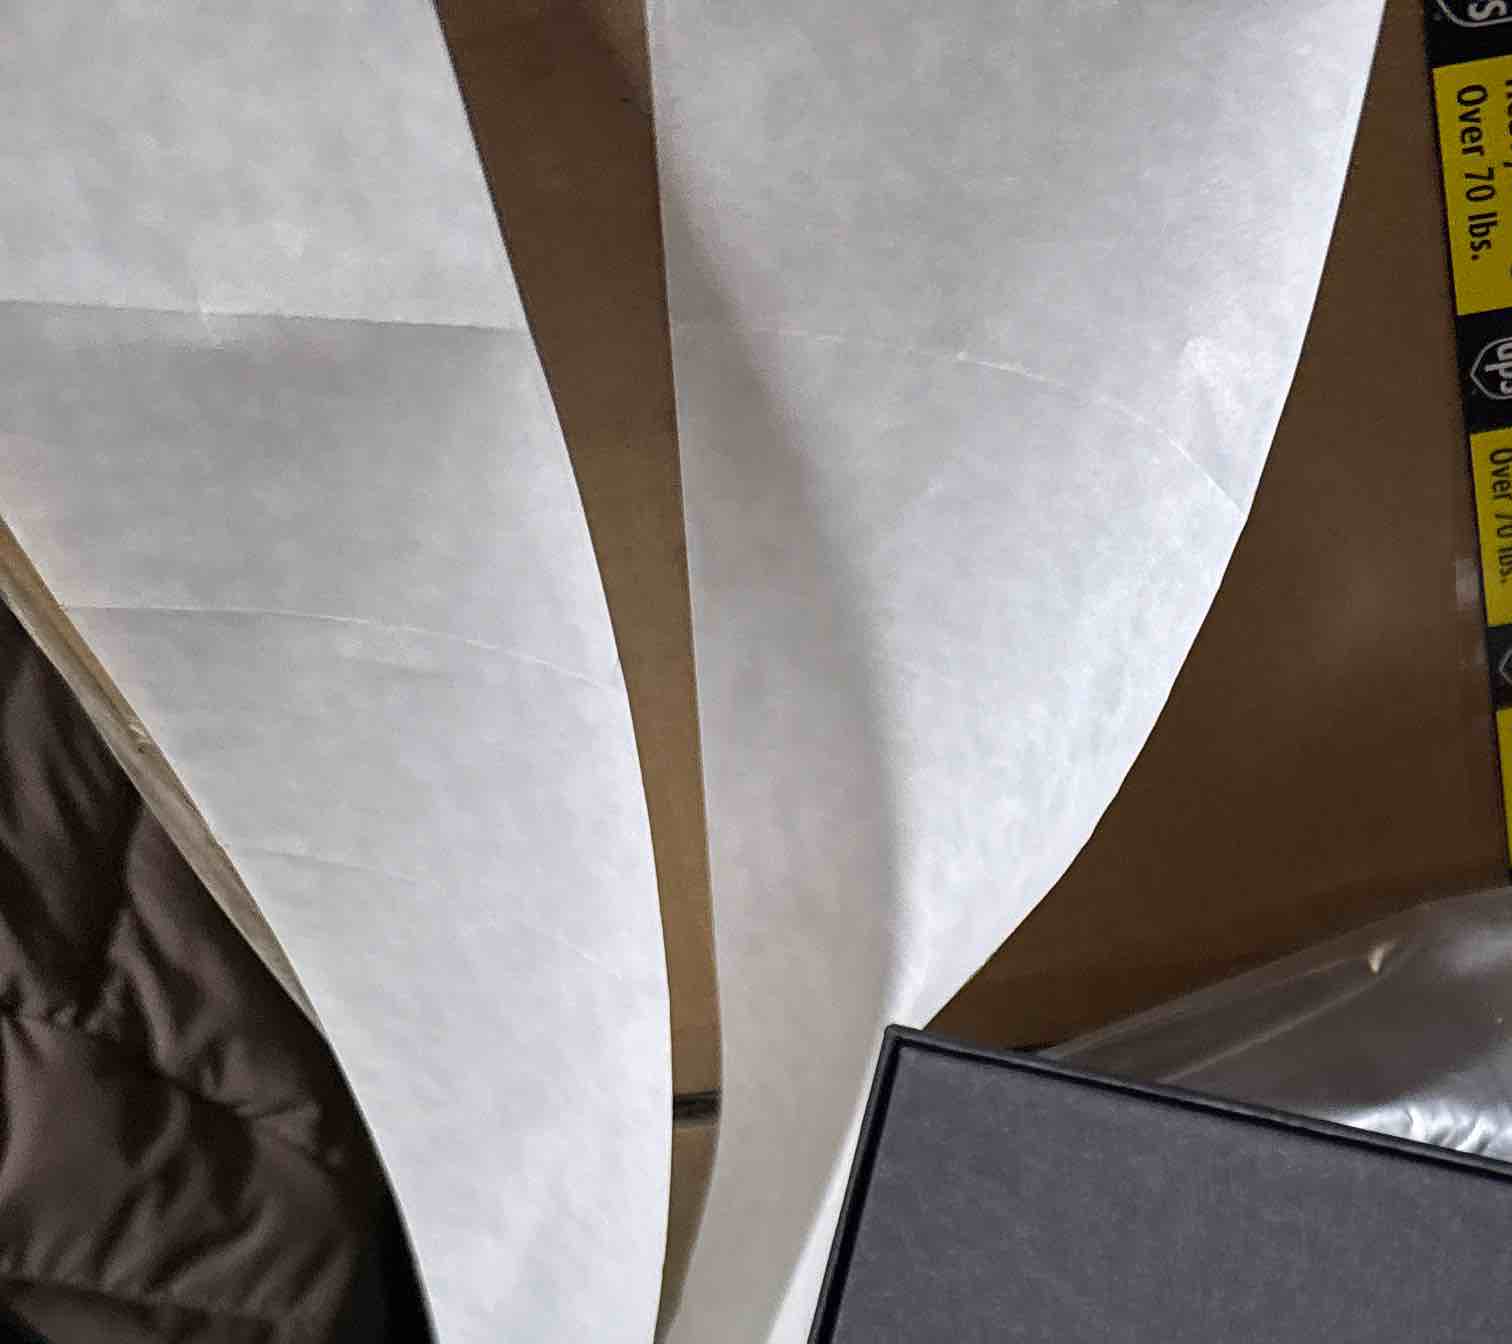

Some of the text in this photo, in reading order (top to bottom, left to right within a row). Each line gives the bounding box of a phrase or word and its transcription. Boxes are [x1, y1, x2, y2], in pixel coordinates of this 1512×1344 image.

[1456, 83, 1499, 263] Over 70 lbs.
